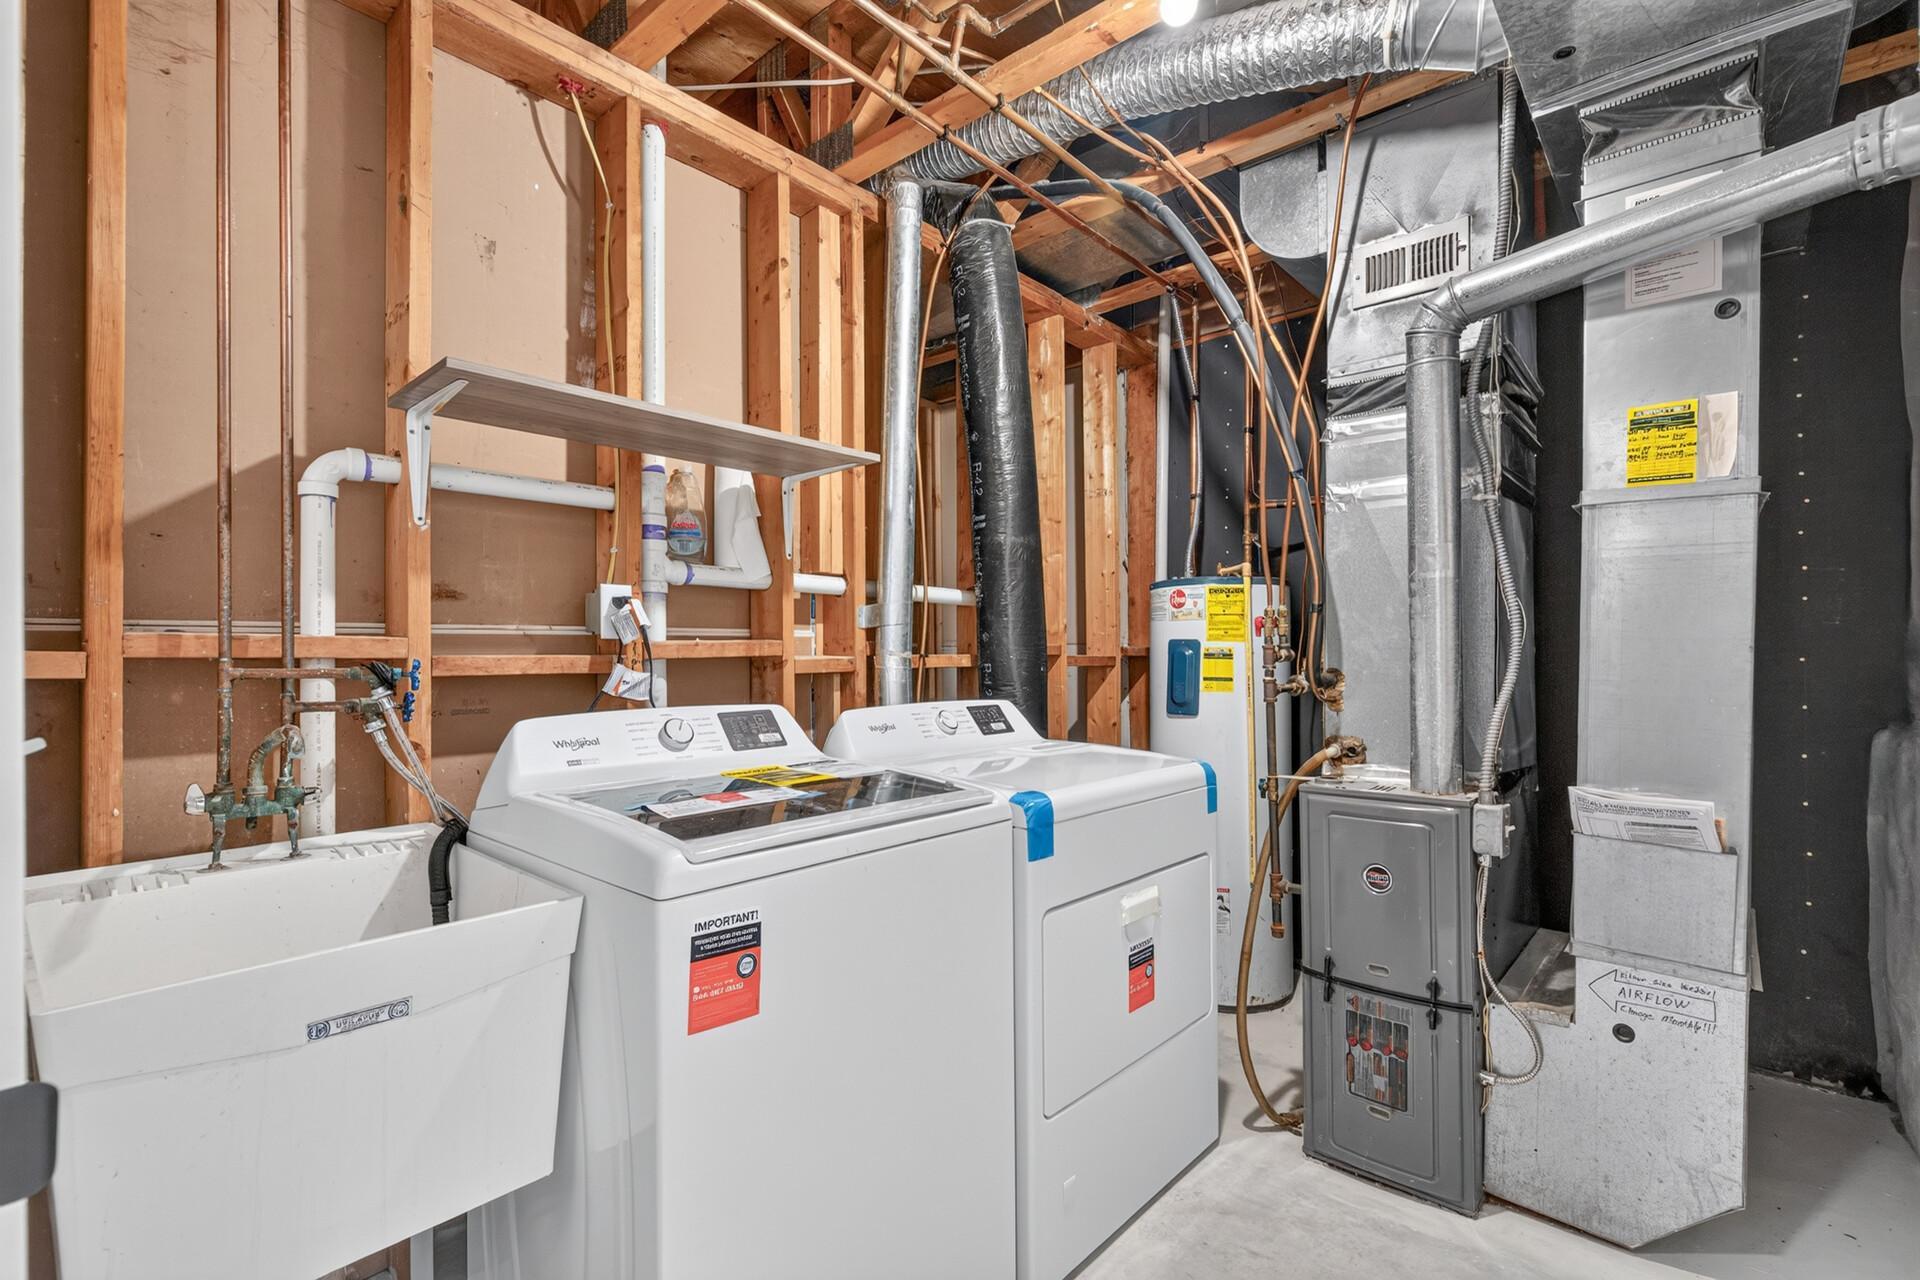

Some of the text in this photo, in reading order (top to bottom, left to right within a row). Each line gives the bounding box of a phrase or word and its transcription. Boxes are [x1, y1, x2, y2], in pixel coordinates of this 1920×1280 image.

[868, 722, 897, 735] Whirlpool
[552, 736, 601, 751] Whirlpool
[694, 910, 759, 933] IMPORTANT!
[1618, 986, 1691, 1009] AIRFLOW
